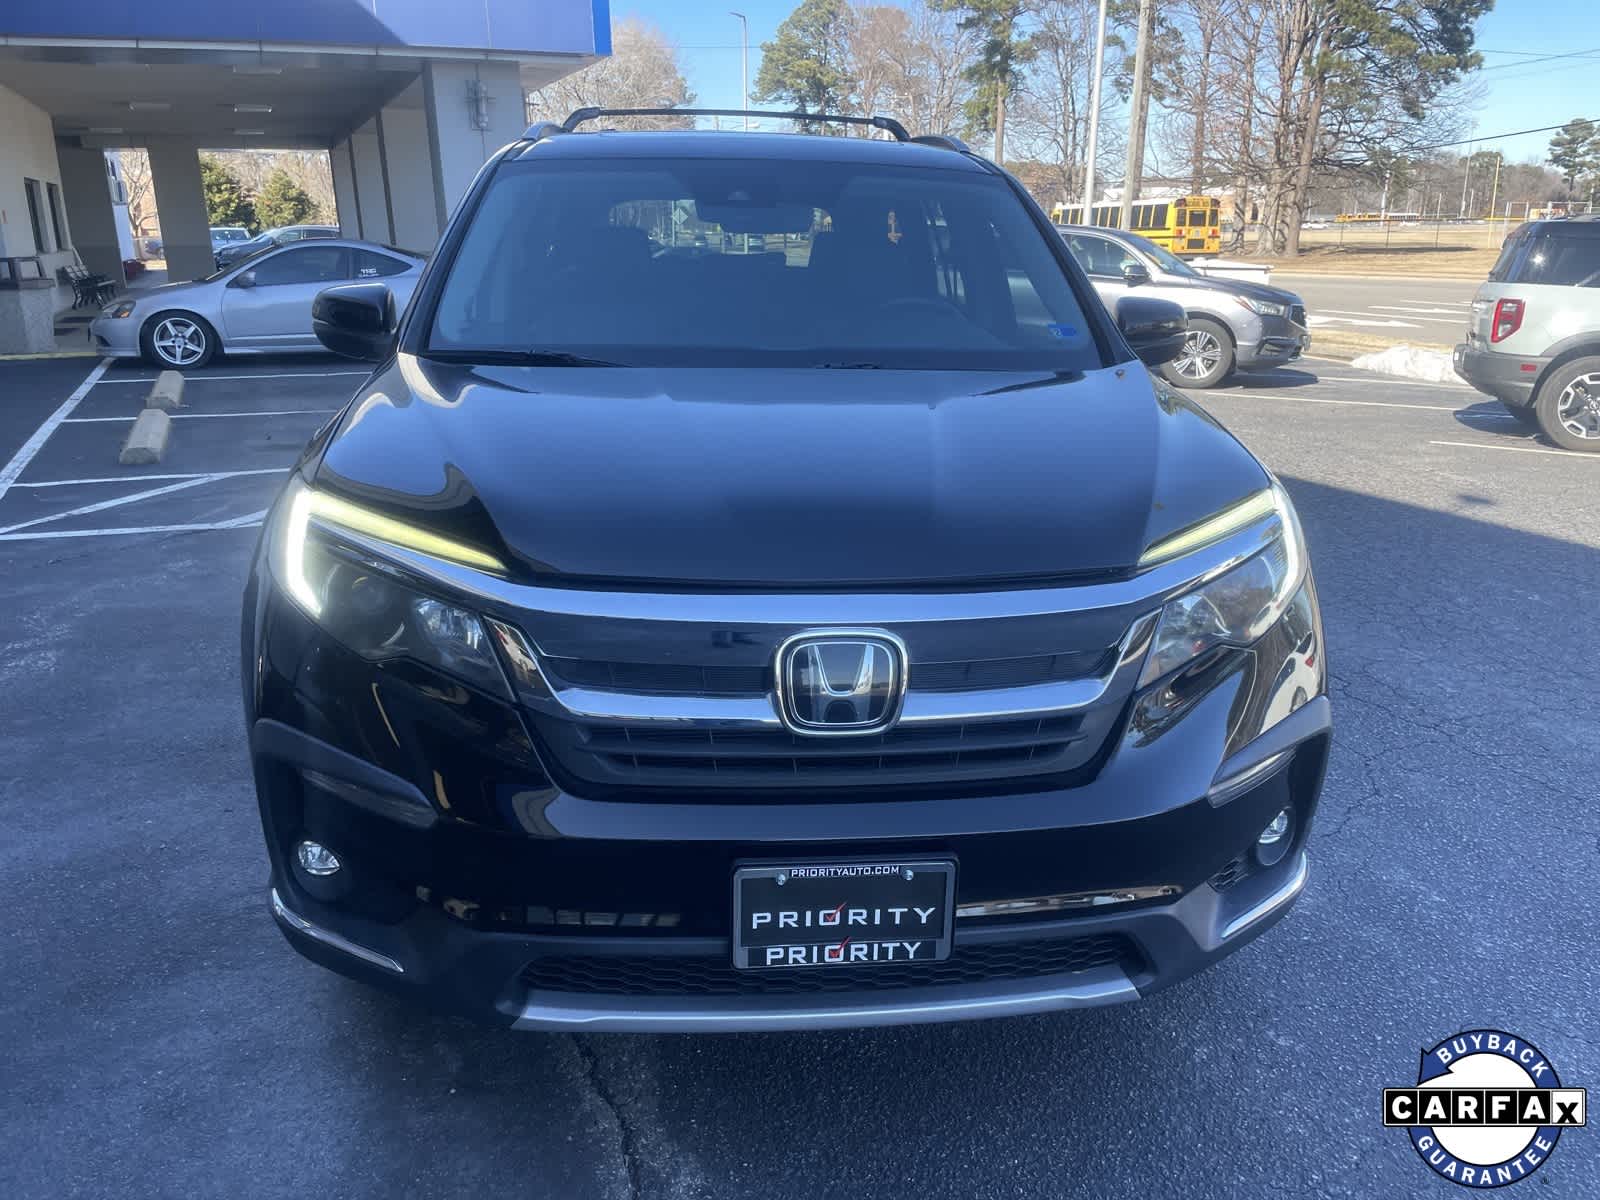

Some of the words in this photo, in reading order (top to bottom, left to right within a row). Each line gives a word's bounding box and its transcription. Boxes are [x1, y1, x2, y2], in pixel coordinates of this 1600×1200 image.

[791, 866, 899, 877] PRIORITYAUTO.COM
[752, 907, 936, 929] PRIORITY
[766, 942, 922, 965] PRIORITY
